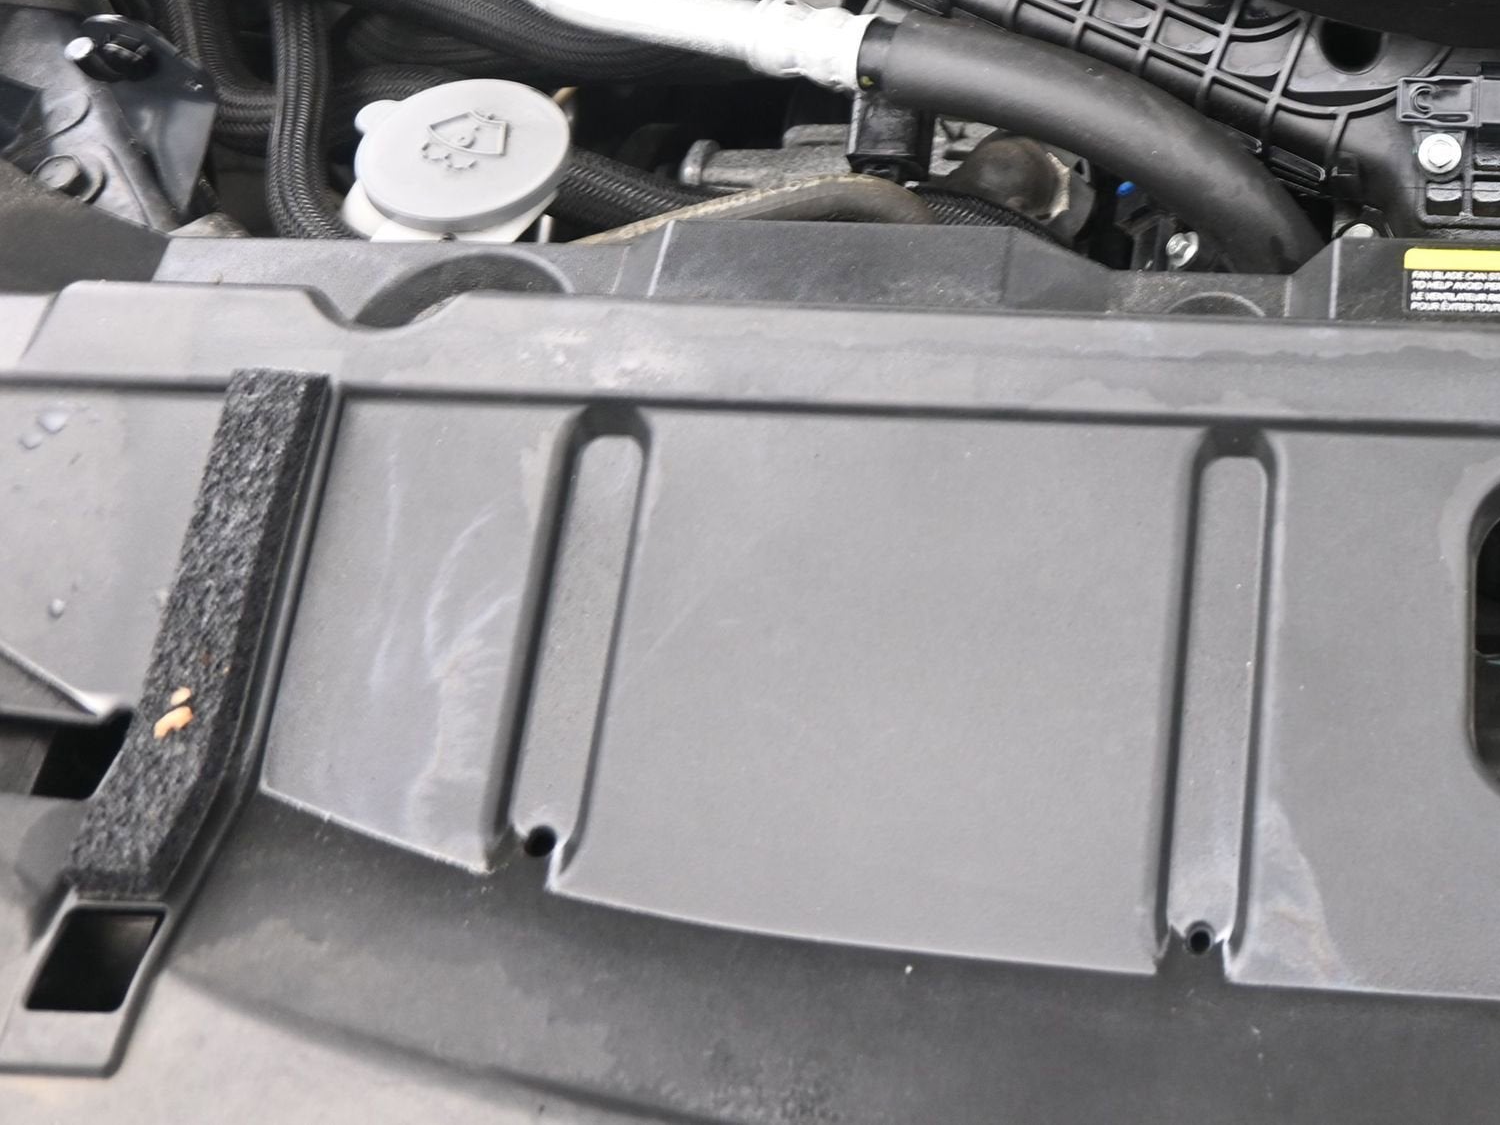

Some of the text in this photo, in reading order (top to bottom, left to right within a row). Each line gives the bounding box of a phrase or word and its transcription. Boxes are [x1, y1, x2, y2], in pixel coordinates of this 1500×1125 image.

[1411, 270, 1432, 279] FAN
[1464, 271, 1488, 281] CAN
[1411, 280, 1427, 290] TO
[1426, 280, 1454, 290] HELP
[1452, 280, 1484, 291] AVOID
[1410, 291, 1425, 301] LE
[1424, 291, 1488, 302] VENTILATEUR
[1410, 301, 1440, 311] POUR
